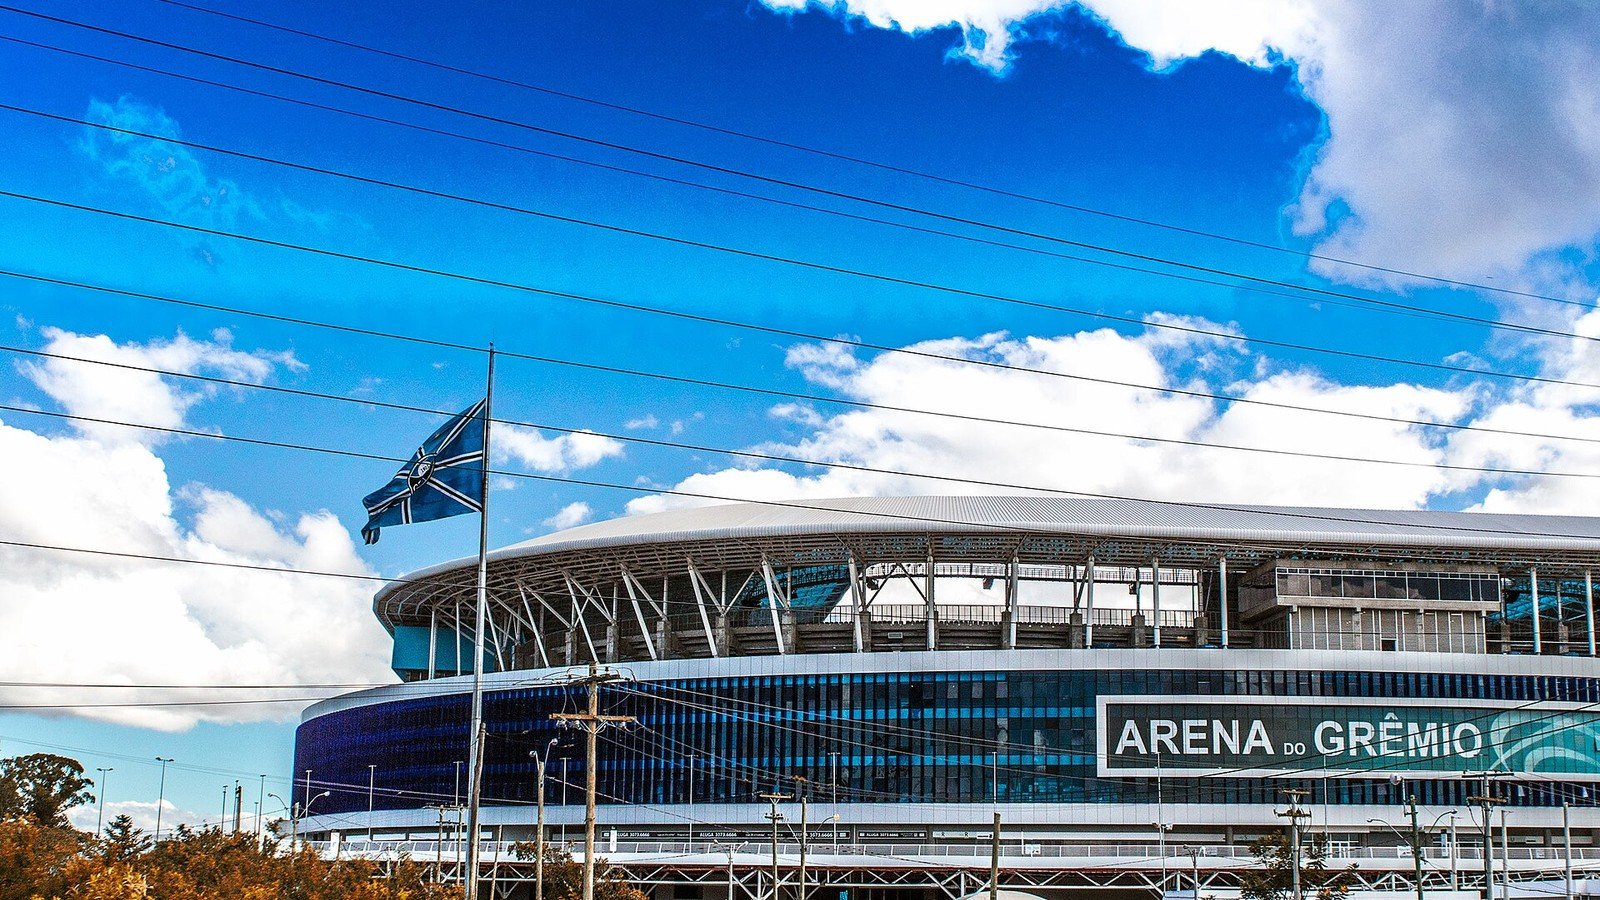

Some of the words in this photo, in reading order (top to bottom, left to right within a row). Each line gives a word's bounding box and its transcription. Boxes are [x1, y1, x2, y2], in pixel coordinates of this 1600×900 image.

[1115, 719, 1275, 755] ARENA
[1283, 742, 1306, 756] DO
[1314, 712, 1482, 758] GRÊMIO
